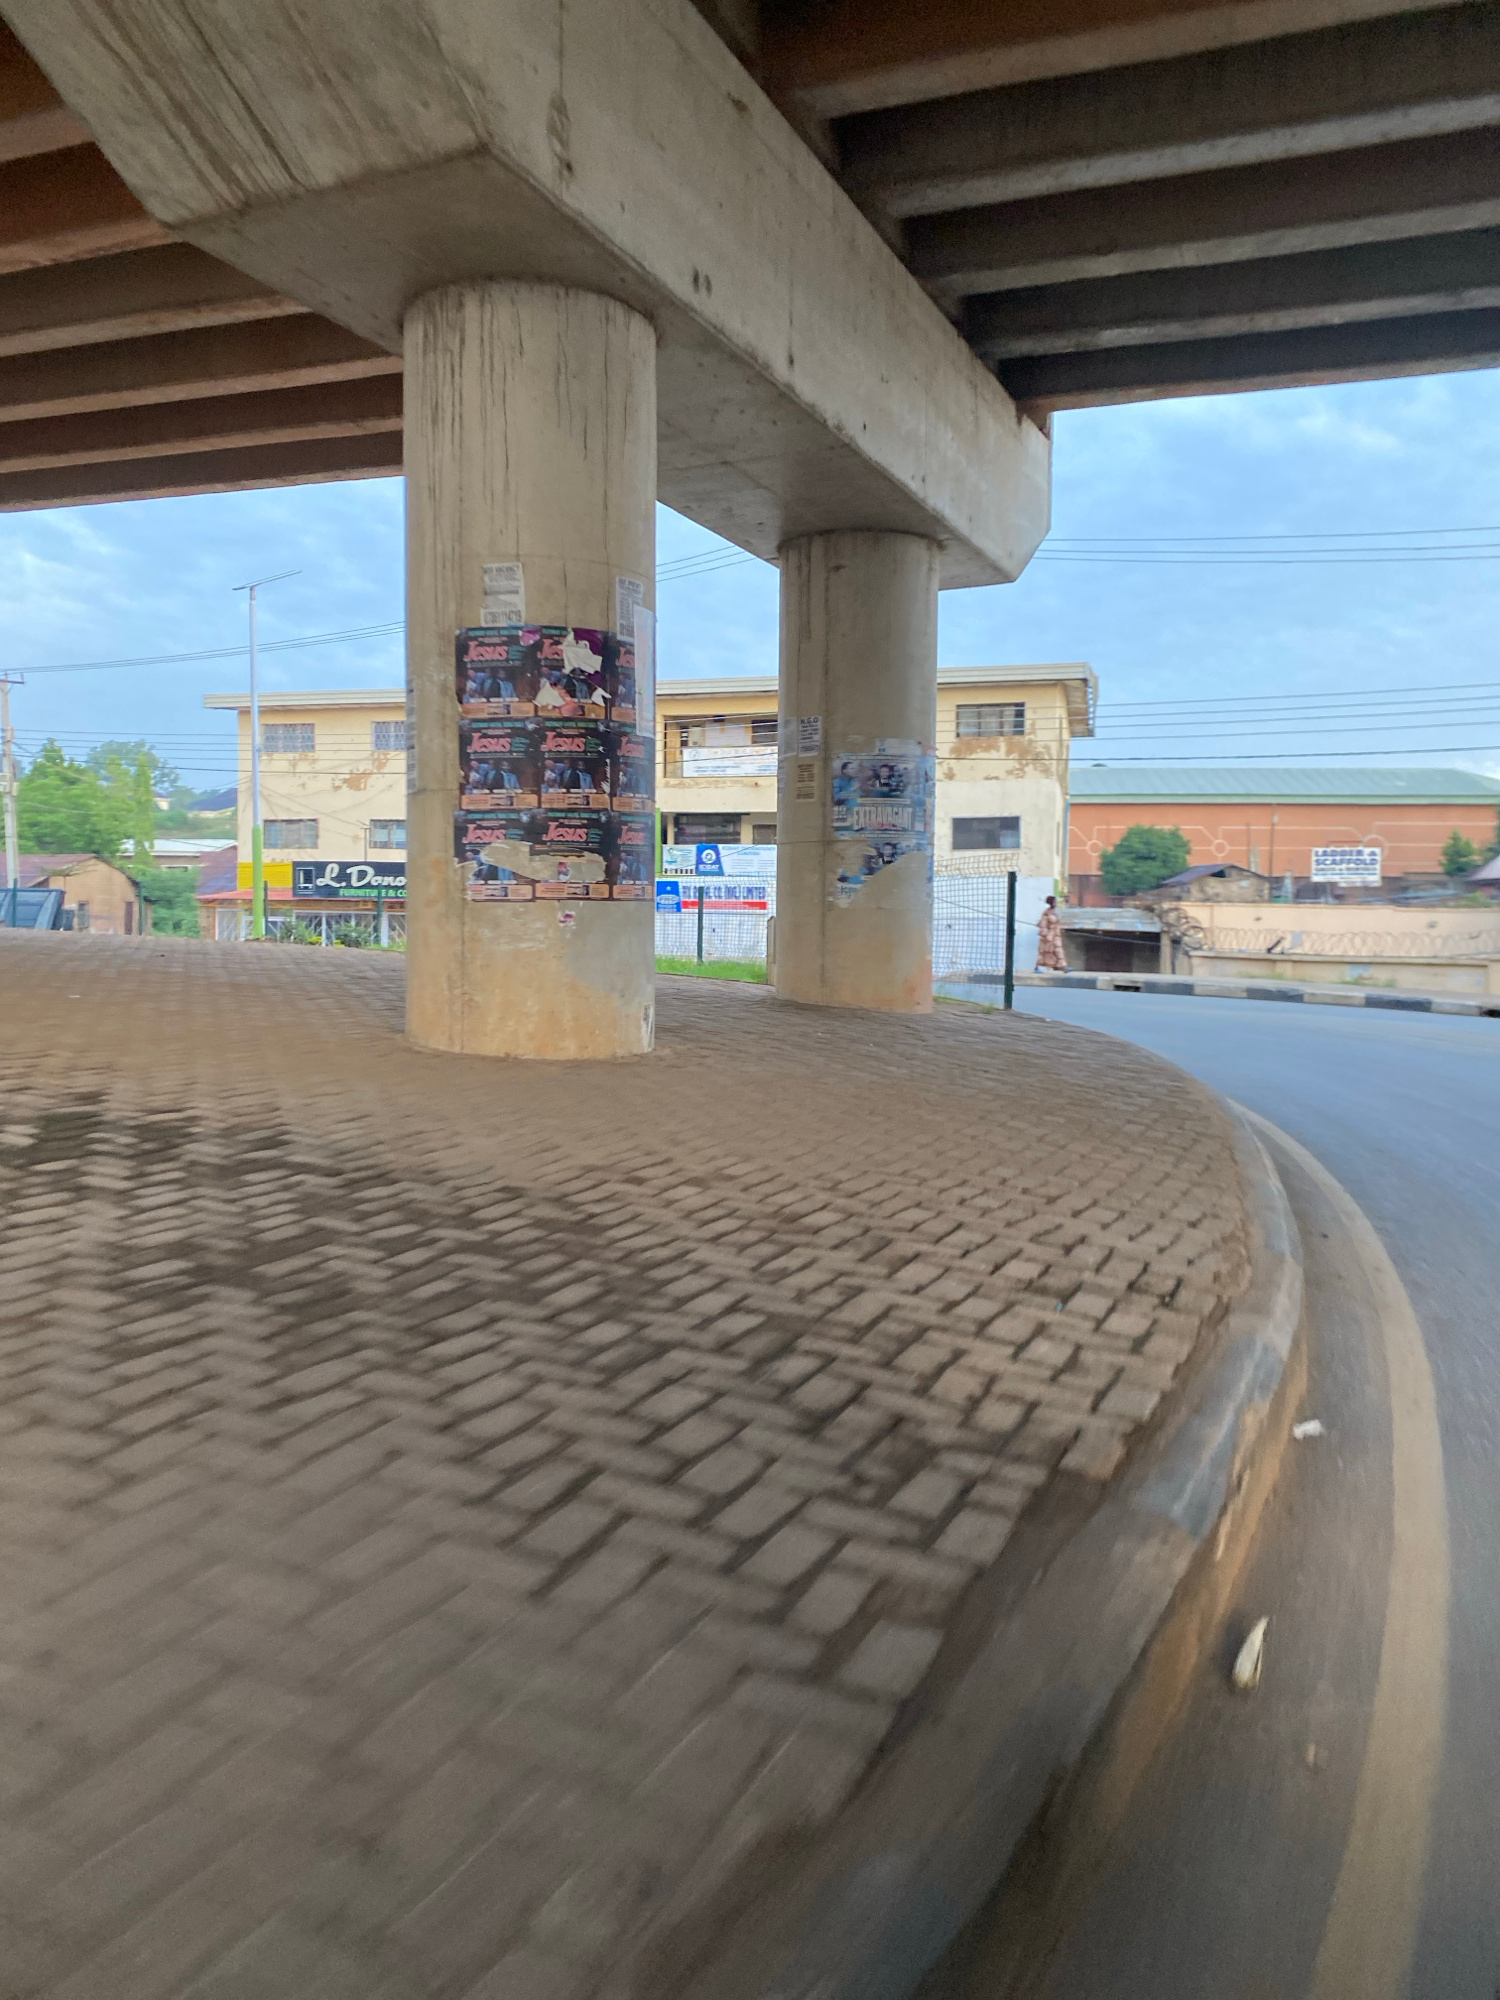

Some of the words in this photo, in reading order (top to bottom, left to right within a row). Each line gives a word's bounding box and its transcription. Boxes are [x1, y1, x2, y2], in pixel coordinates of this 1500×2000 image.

[465, 641, 508, 662] Jesus
[467, 732, 511, 753] Jesus
[540, 731, 586, 752] Jesus
[853, 806, 913, 831] EXTRAVAGANT
[463, 823, 507, 843] Jesus
[542, 822, 588, 842] Jesus
[1314, 849, 1364, 857] LADDER
[1315, 858, 1378, 866] SCAFFOLD
[388, 888, 396, 897] &
